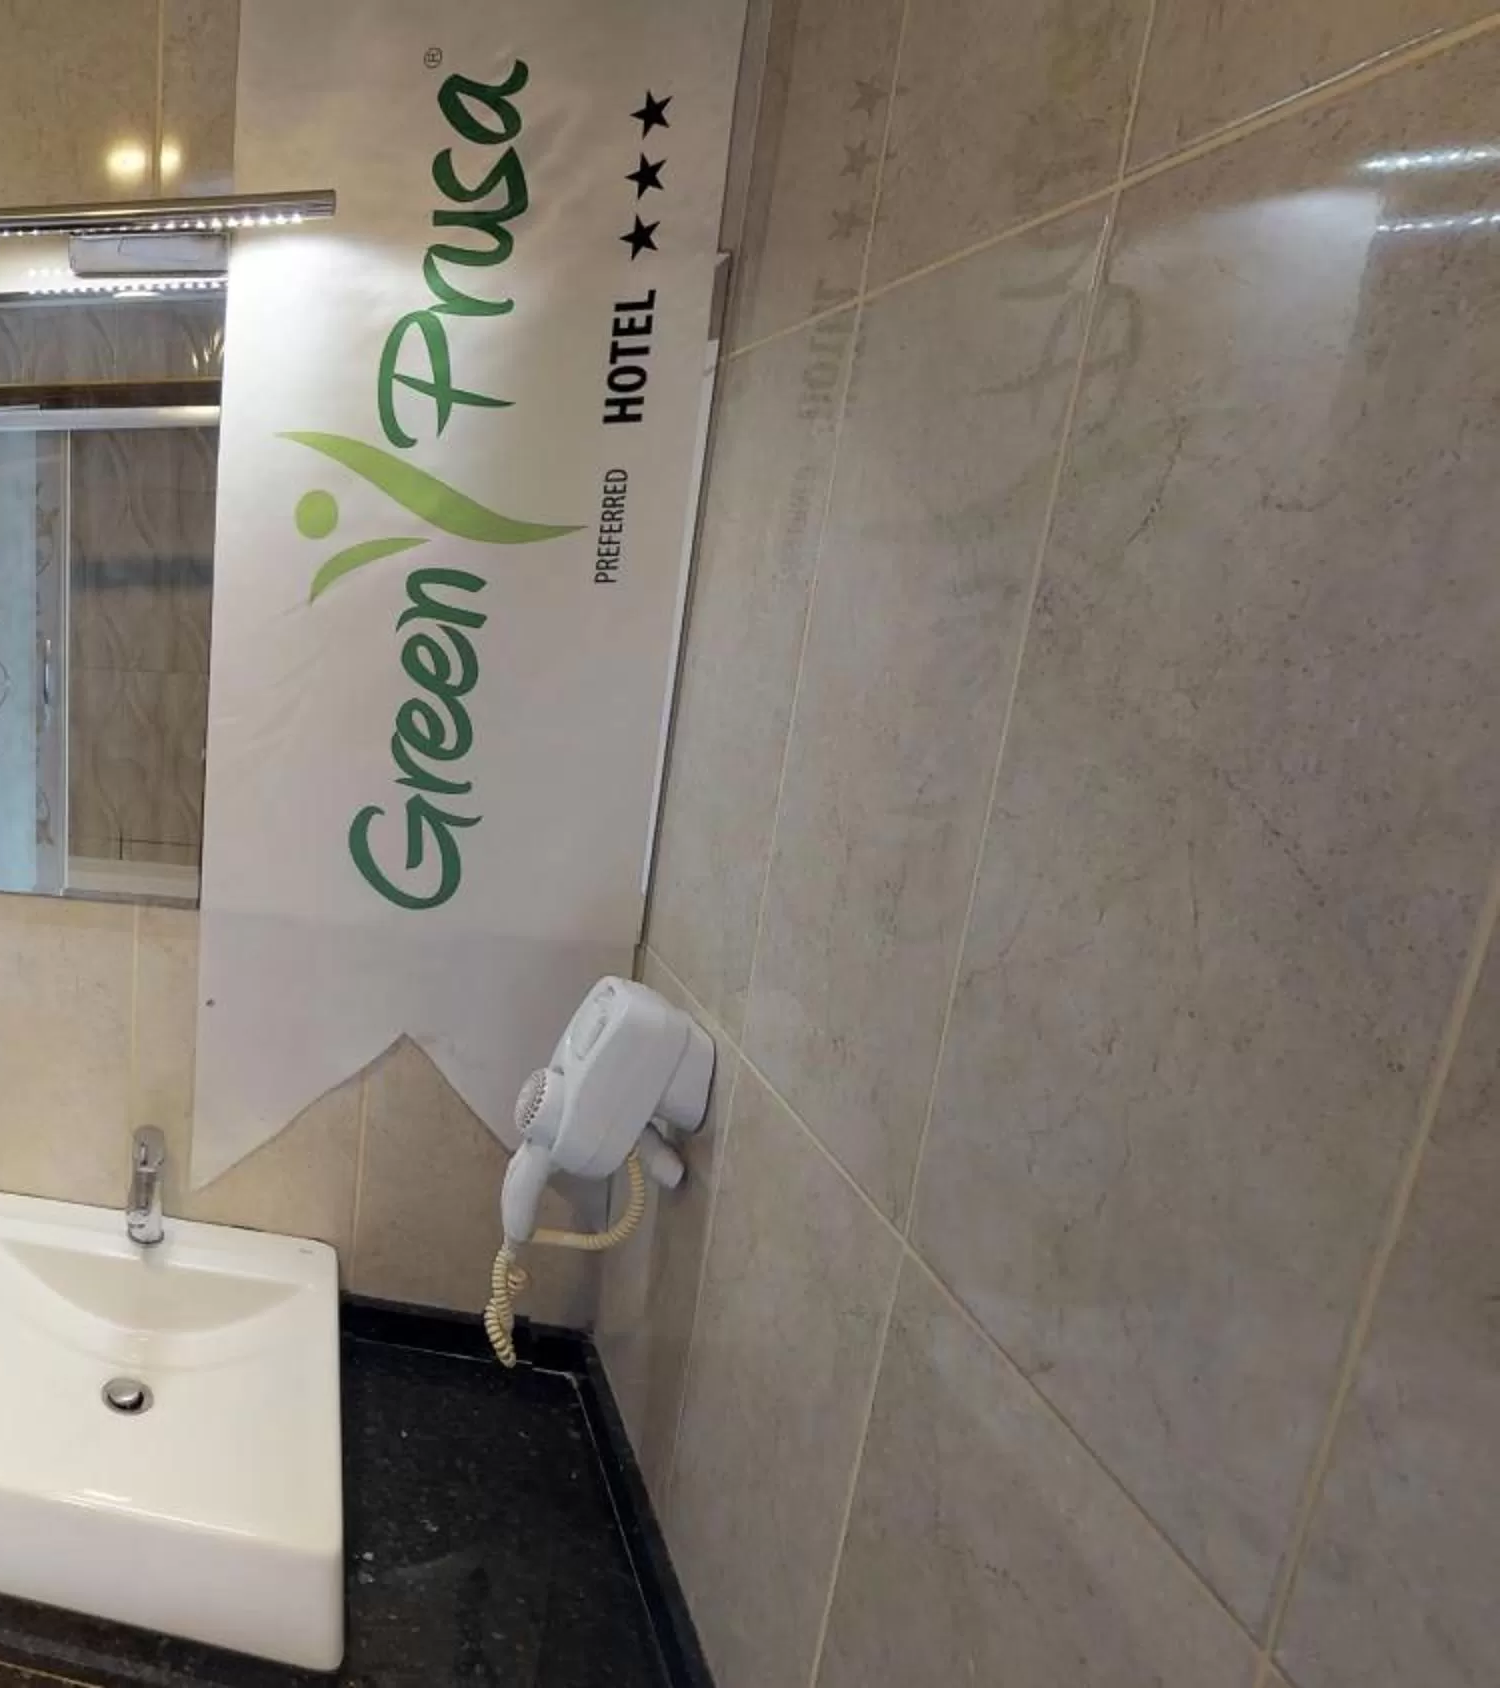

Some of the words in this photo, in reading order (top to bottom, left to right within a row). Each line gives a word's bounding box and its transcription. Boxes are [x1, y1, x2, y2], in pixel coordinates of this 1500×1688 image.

[602, 289, 657, 425] HOTEL
[593, 468, 629, 585] PREFERRED
[348, 567, 488, 910] Green
